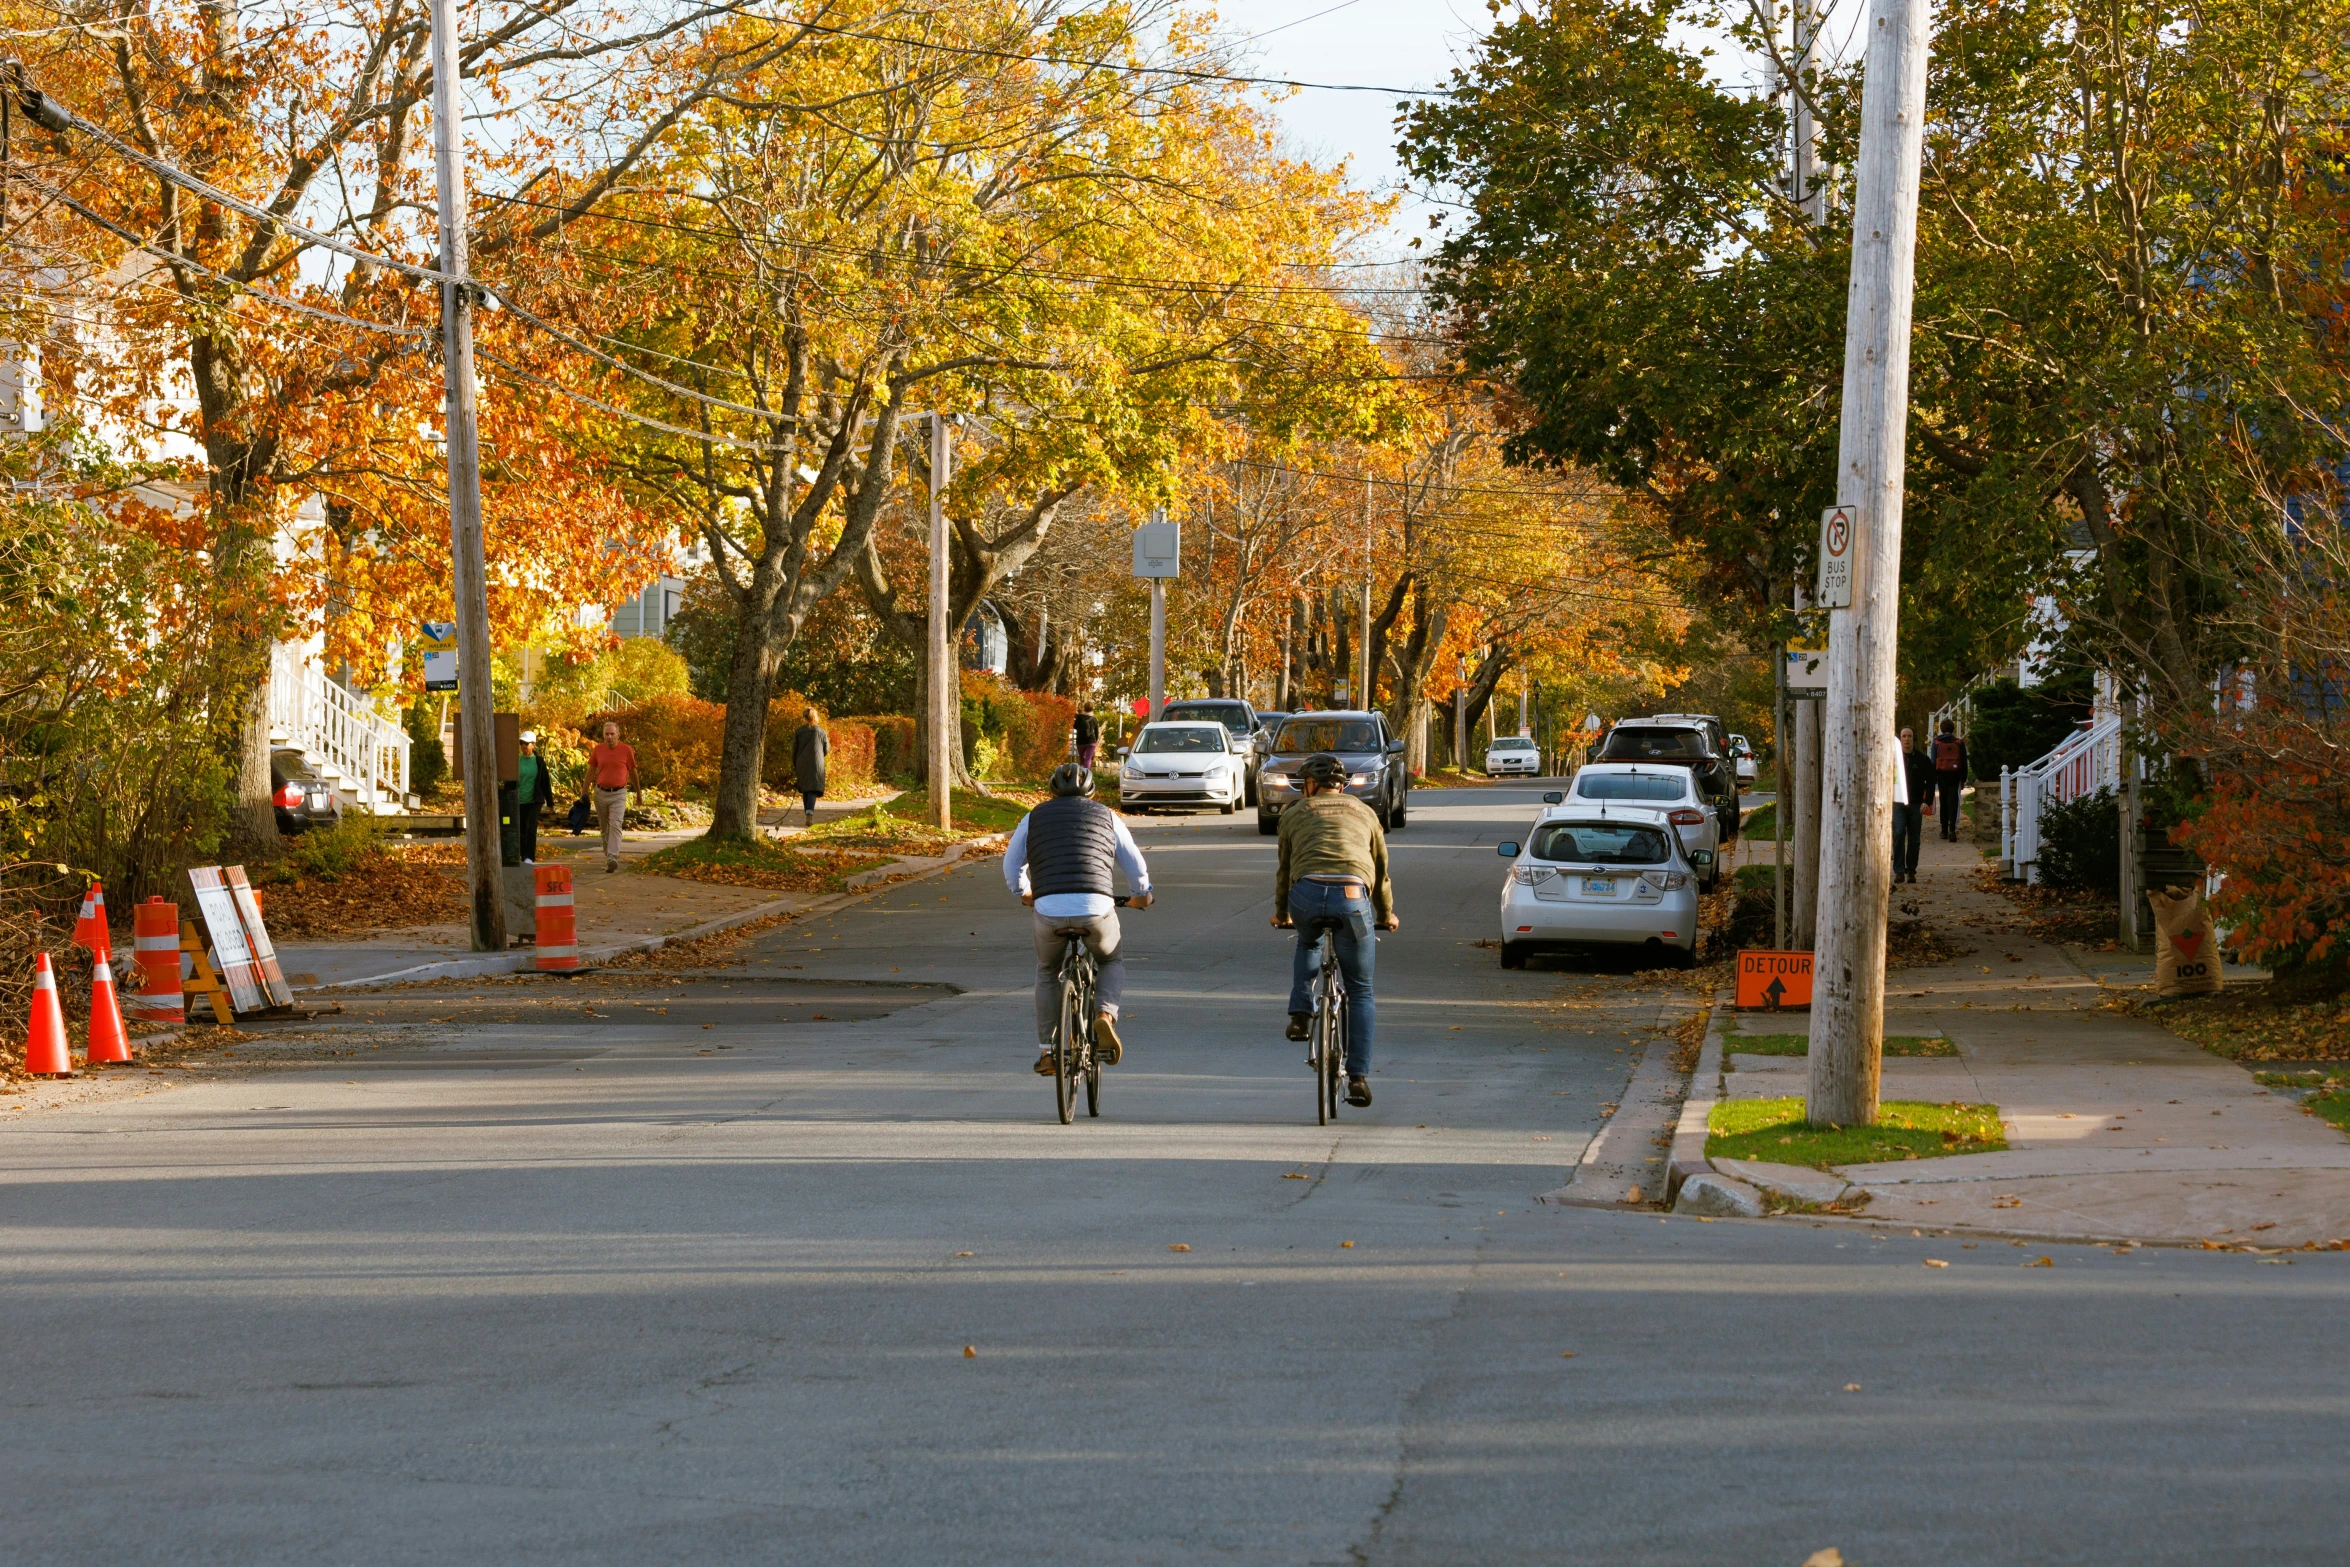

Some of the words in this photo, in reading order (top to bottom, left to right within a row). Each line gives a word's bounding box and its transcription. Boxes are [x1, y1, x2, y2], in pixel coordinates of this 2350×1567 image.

[1827, 560, 1845, 574] BUS
[1825, 575, 1847, 588] STOP
[547, 881, 564, 892] SFC
[209, 902, 231, 921] ROAD
[216, 929, 245, 951] CLOSED
[1744, 957, 1812, 975] DETOUR
[2177, 963, 2207, 977] 100
